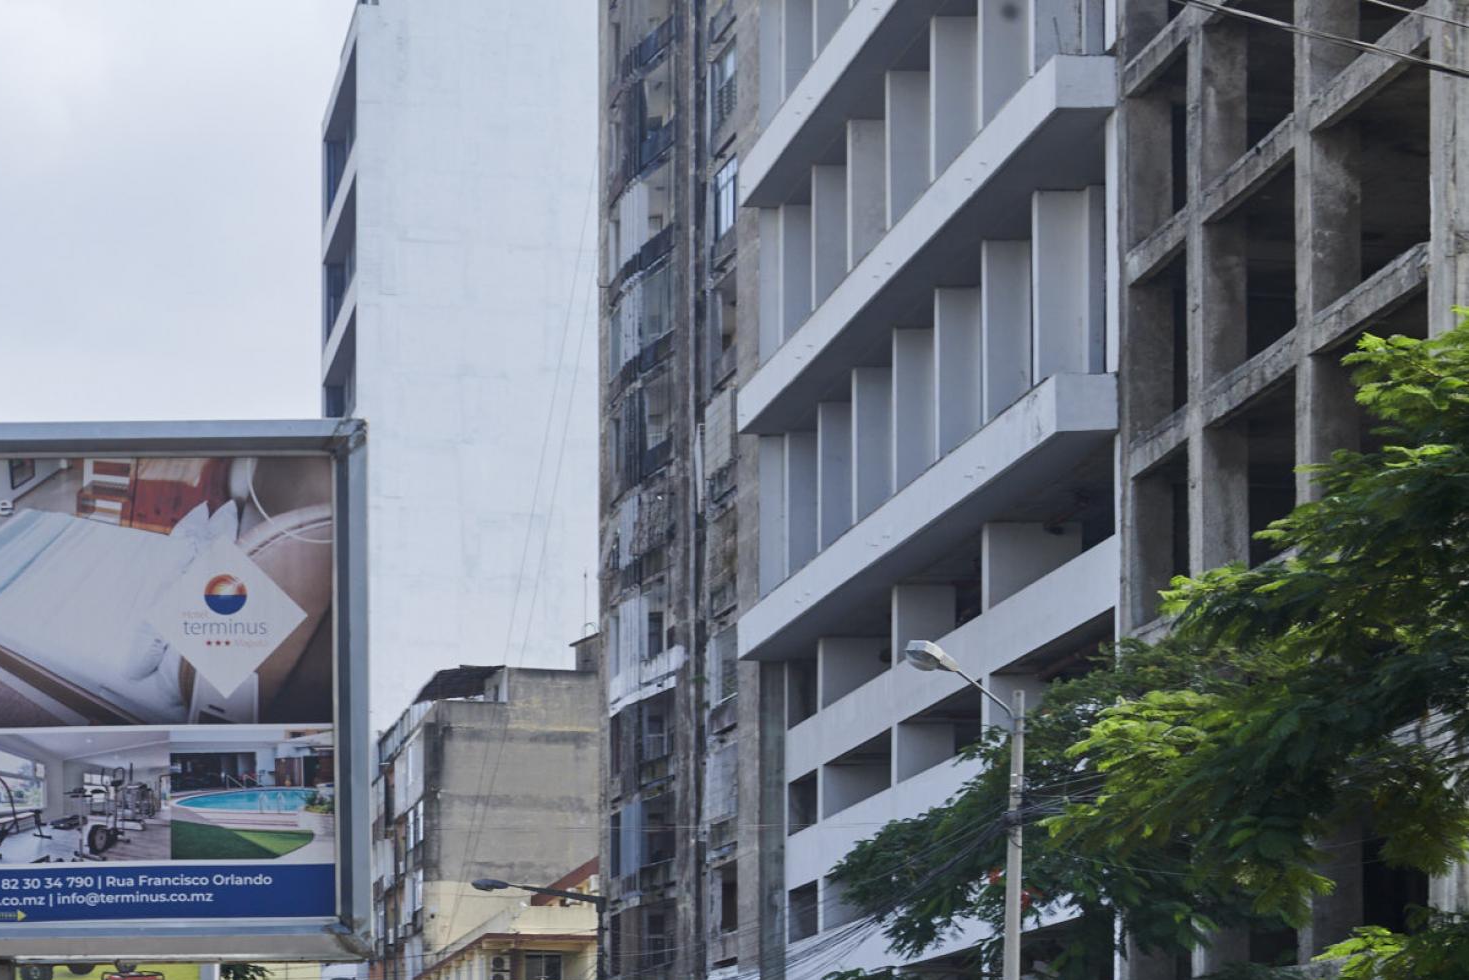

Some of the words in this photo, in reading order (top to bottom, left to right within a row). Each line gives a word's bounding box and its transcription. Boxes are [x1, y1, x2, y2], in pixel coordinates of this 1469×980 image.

[183, 618, 268, 635] terminus
[1, 878, 19, 890] 82
[22, 877, 41, 889] 30
[44, 877, 63, 889] 34
[66, 876, 94, 888] 790
[106, 876, 135, 887] Rua
[138, 874, 209, 887] Francisco
[212, 873, 273, 886] Orlando
[57, 891, 214, 907] info@terminus.co.mz
